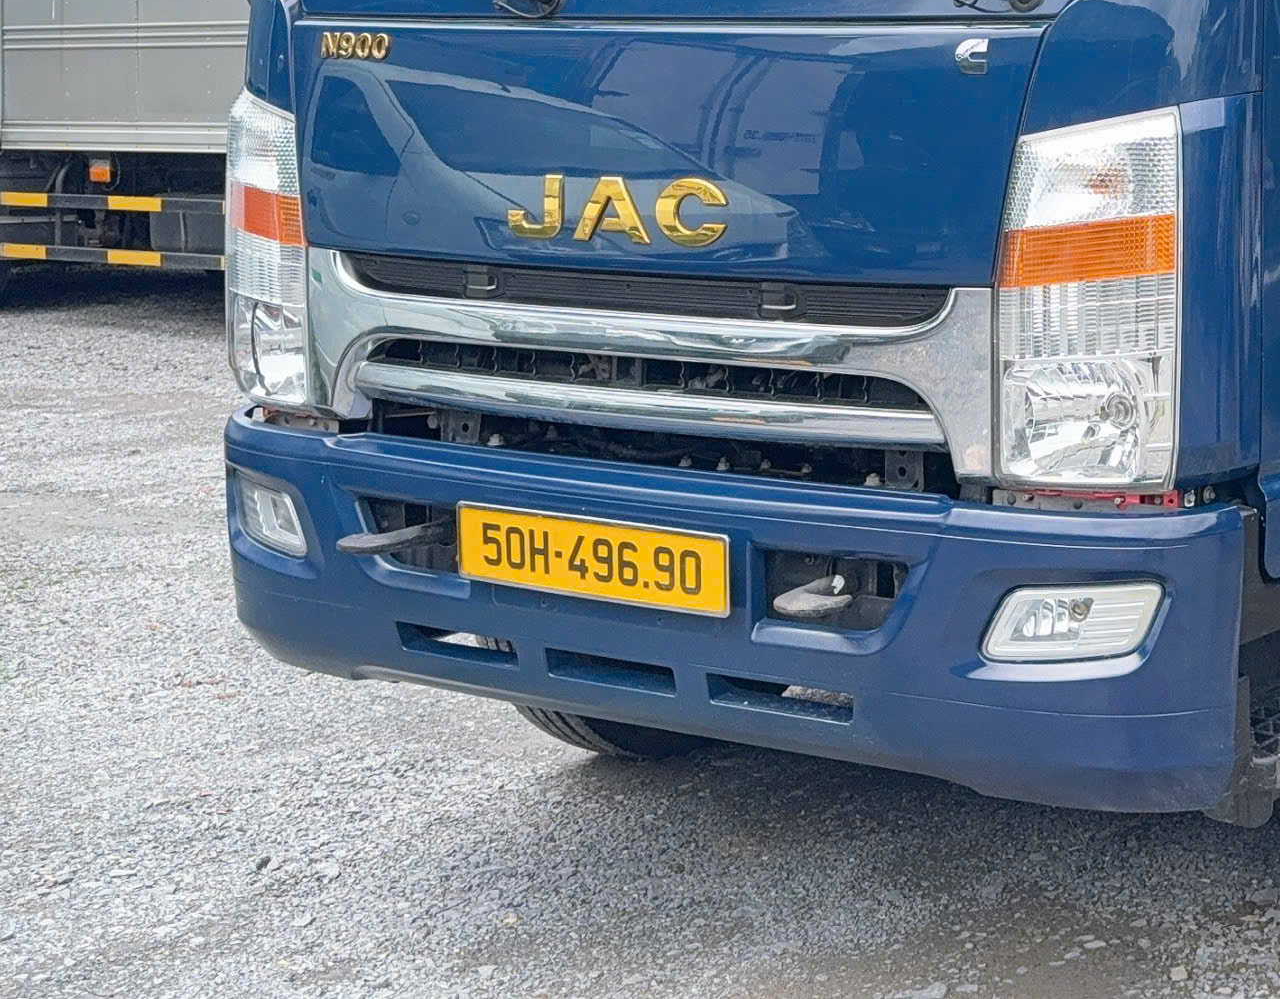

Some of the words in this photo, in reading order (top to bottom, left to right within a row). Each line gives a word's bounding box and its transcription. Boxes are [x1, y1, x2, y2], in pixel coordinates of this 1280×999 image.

[320, 31, 389, 59] N900
[507, 173, 729, 247] JAC
[481, 521, 702, 596] 50H-496.90
